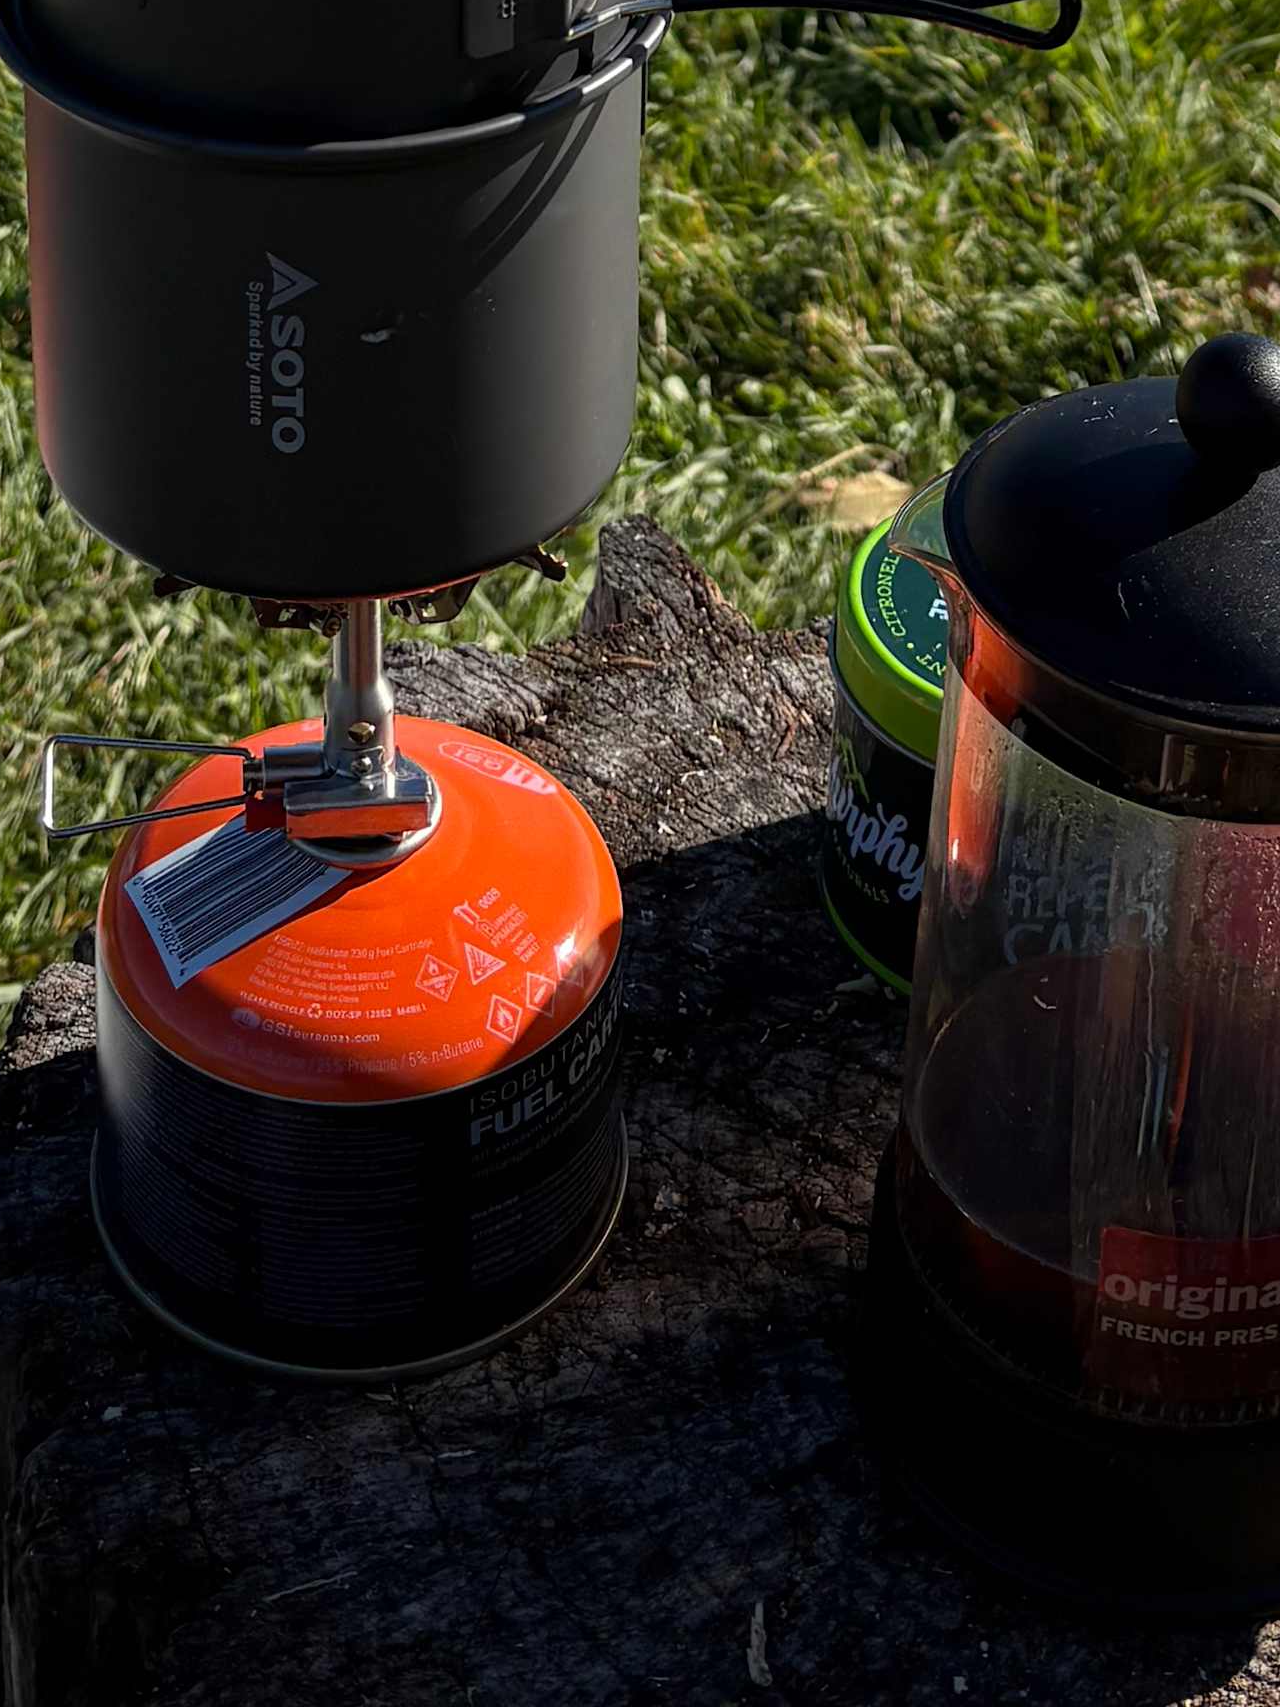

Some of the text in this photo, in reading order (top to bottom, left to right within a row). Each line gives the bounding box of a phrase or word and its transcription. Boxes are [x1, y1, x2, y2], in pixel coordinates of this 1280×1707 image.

[245, 281, 264, 426] Sparked by nature
[270, 314, 307, 454] SOTO
[877, 549, 907, 637] CITRONEL
[826, 755, 925, 901] urphy
[469, 1076, 564, 1146] FUEL
[1100, 1315, 1205, 1347] FRENCH
